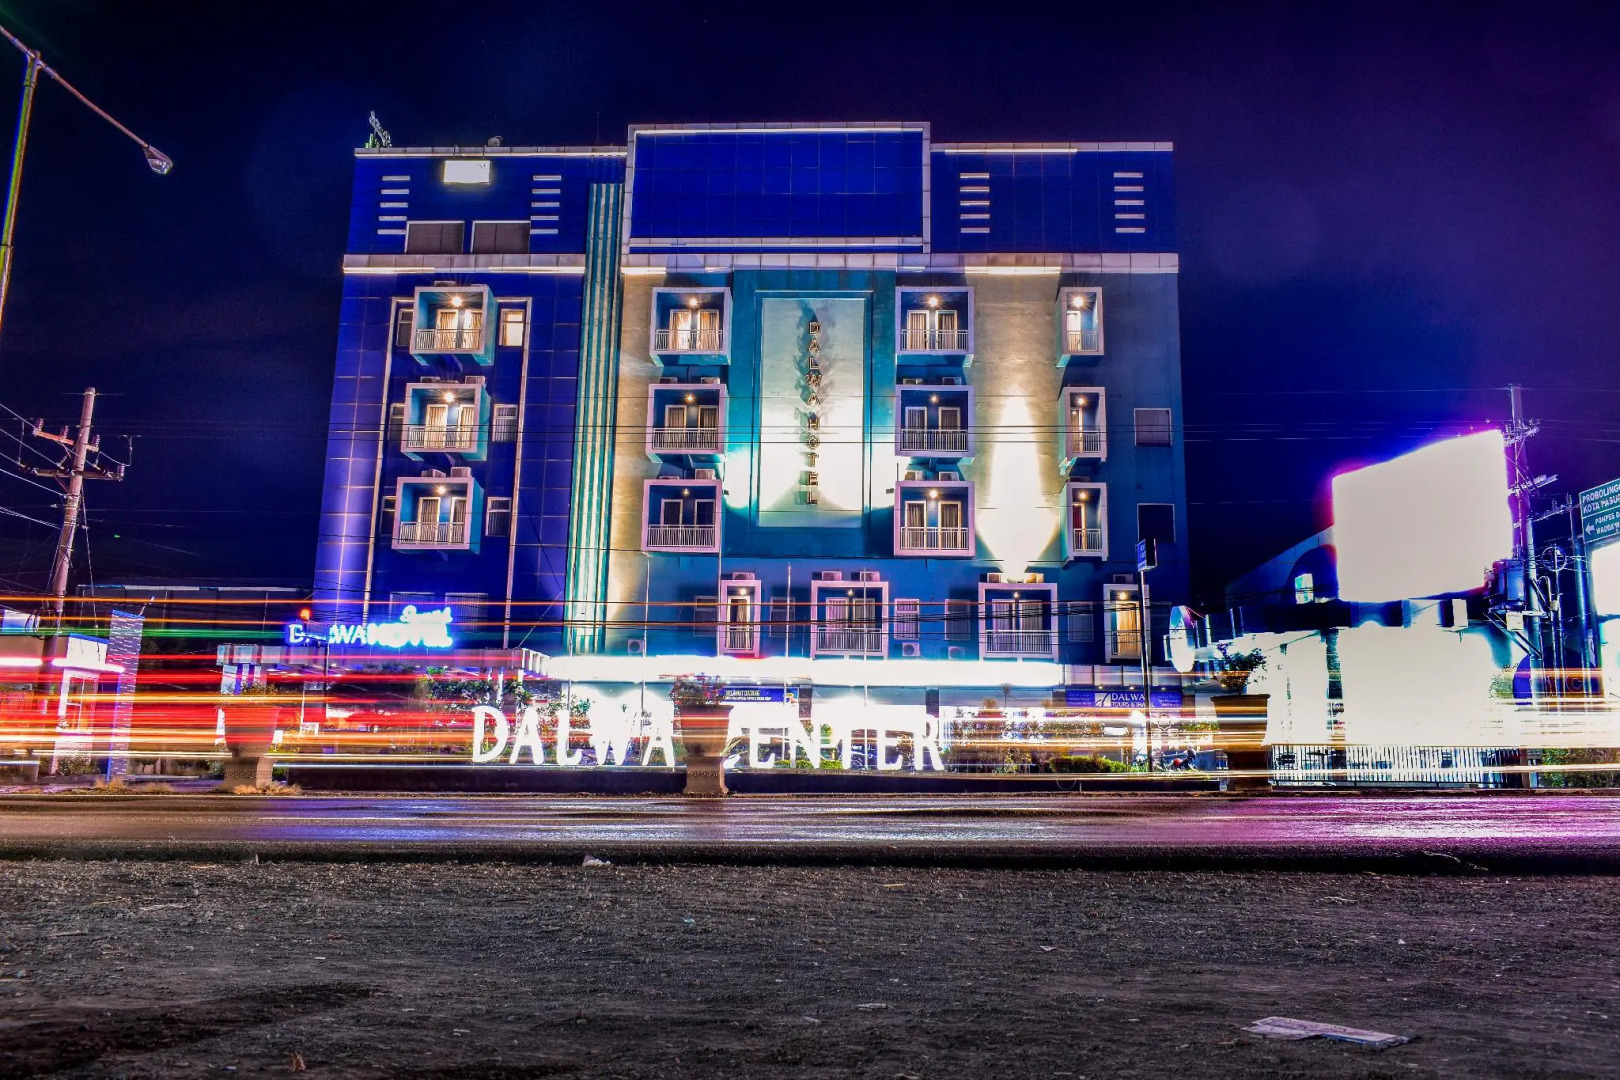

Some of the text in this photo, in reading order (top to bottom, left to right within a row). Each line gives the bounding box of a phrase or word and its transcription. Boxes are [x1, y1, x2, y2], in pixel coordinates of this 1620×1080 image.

[805, 321, 823, 505] DALWA HOTEL
[1583, 503, 1600, 514] KOTA
[1111, 692, 1146, 701] DALWA
[471, 705, 676, 766] DALWA
